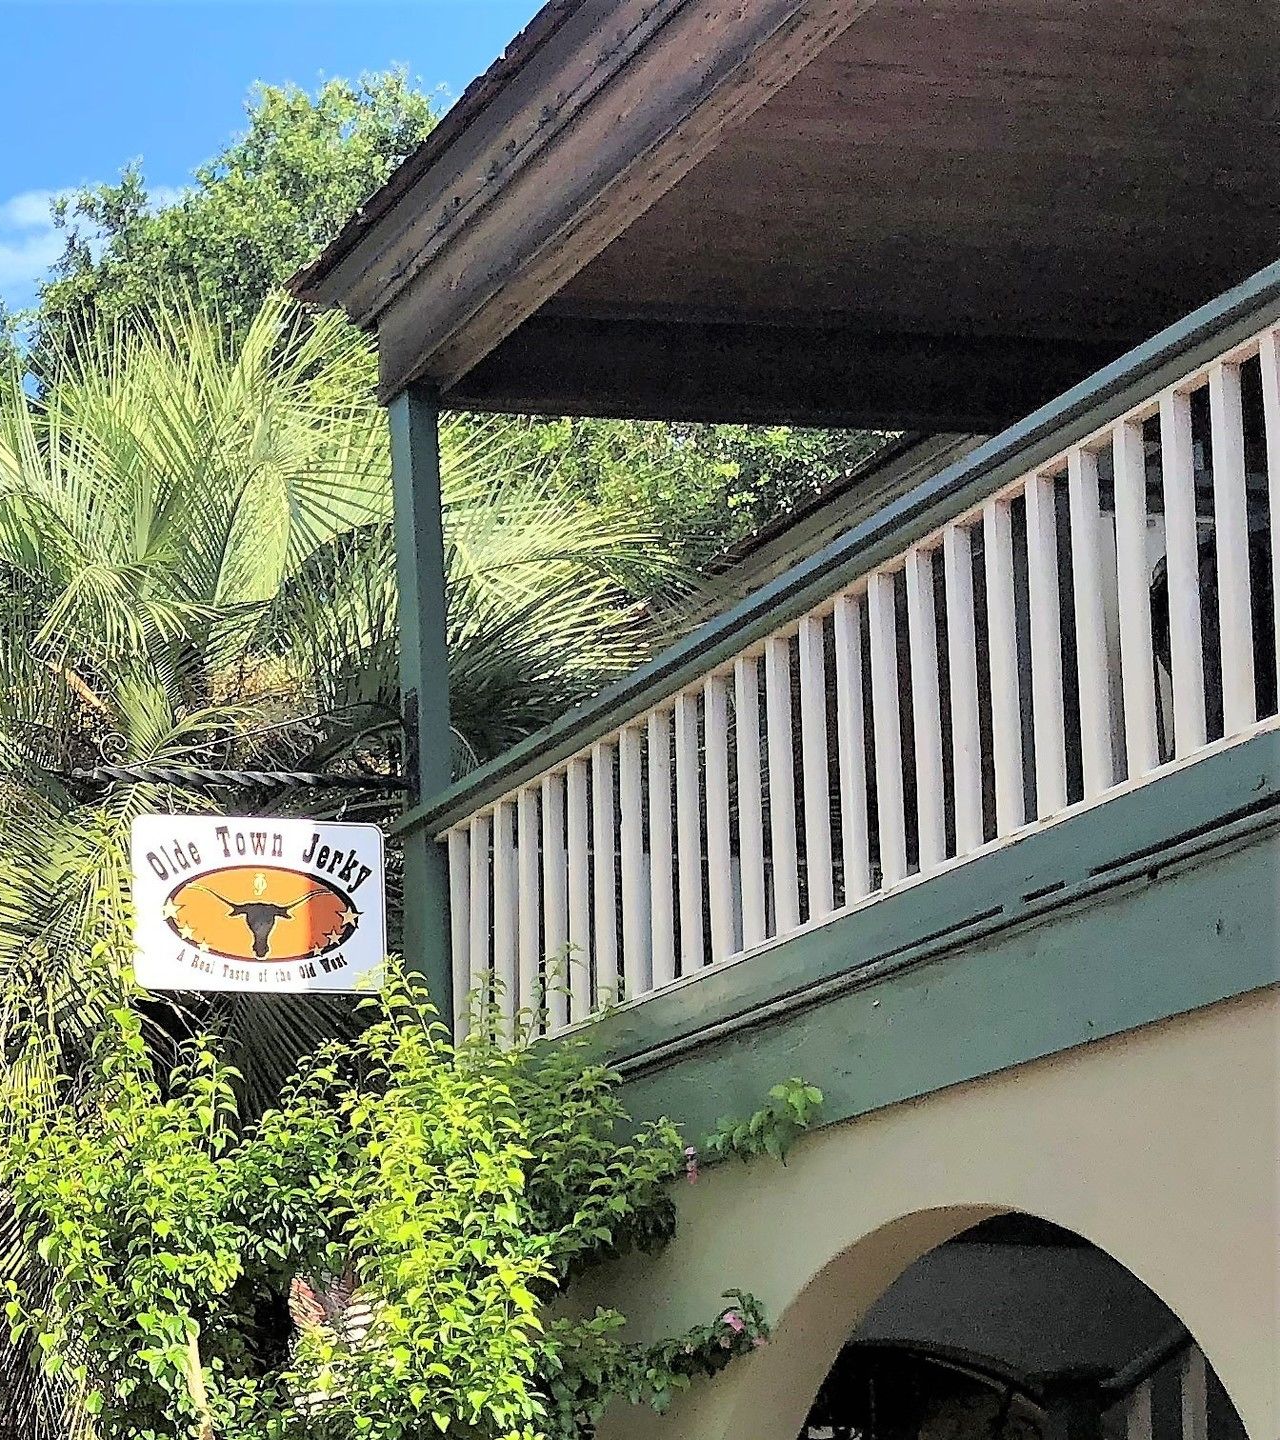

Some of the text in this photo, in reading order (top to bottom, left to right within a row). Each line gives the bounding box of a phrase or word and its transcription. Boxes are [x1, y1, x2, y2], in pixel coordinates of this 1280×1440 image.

[146, 826, 372, 893] Olde Town Jerky
[176, 949, 186, 962] A
[222, 964, 251, 982] Taste
[257, 969, 268, 983] of
[275, 969, 292, 983] the
[298, 962, 317, 980] Old
[319, 952, 348, 973] West
